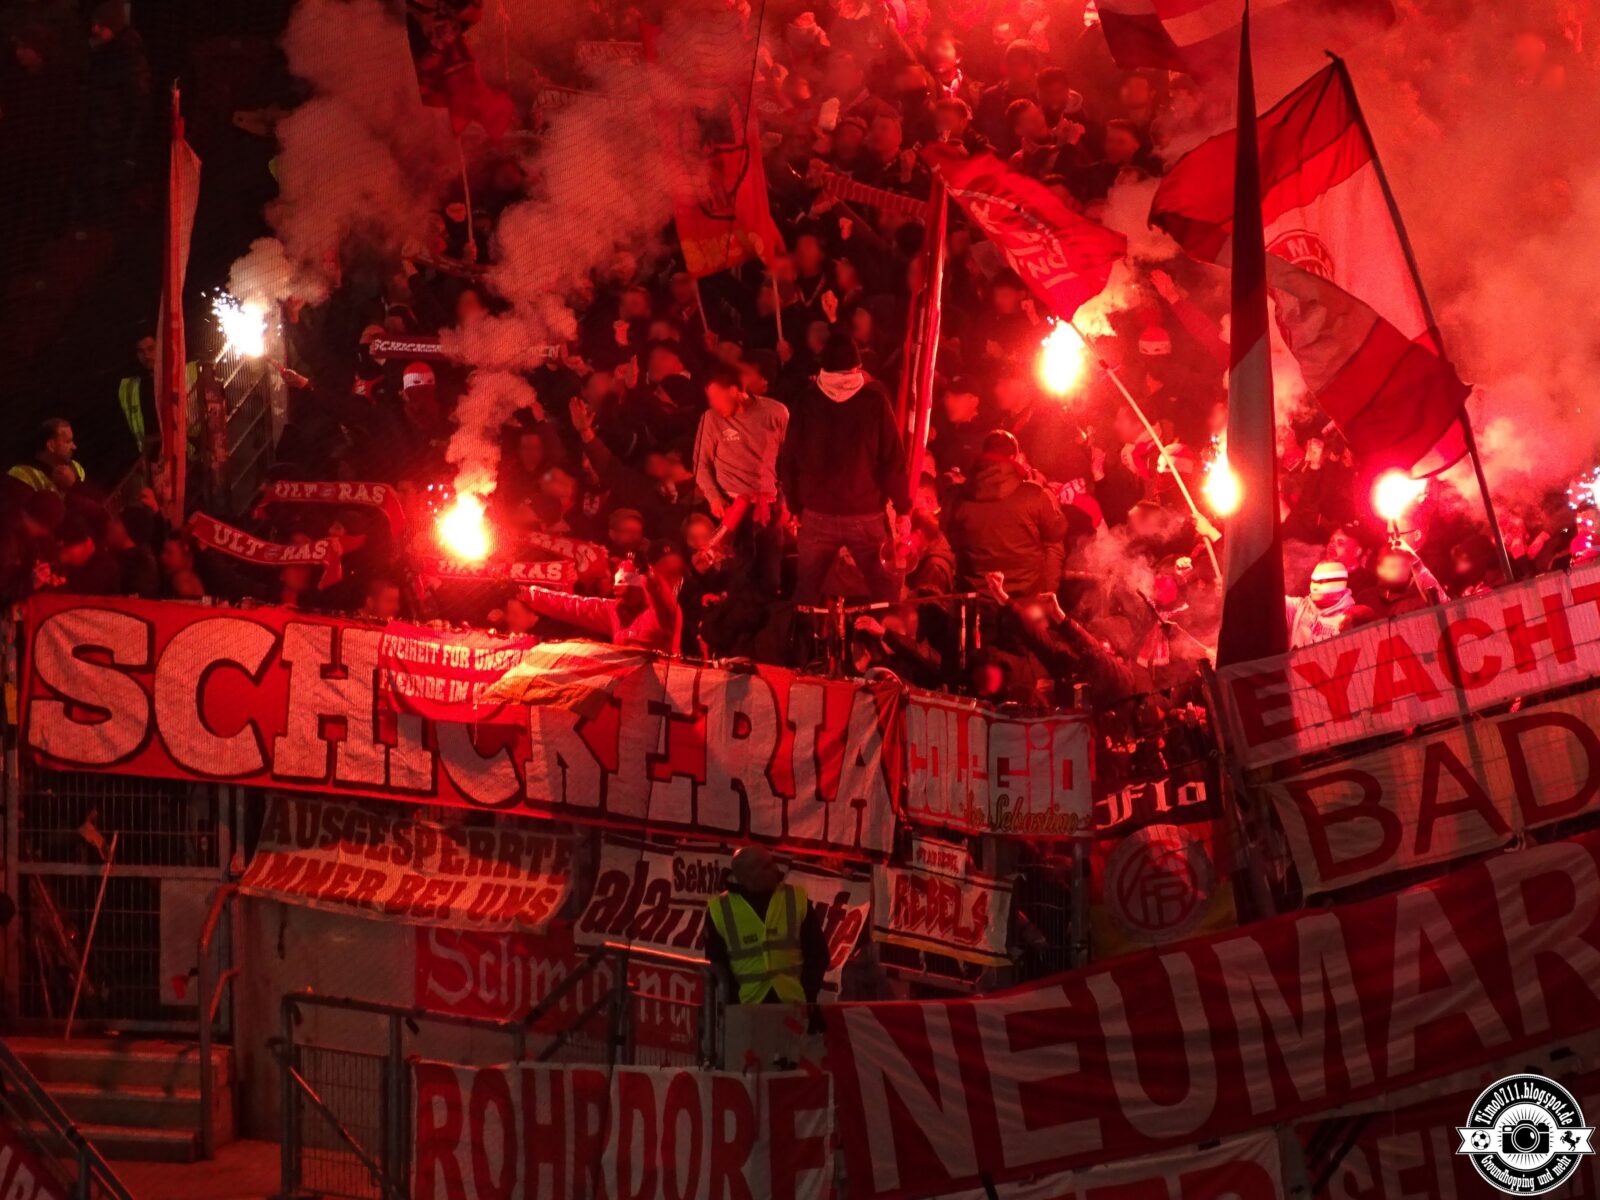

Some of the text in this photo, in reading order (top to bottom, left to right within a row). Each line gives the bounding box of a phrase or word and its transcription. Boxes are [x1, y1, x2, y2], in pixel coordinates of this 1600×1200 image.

[1288, 710, 1600, 880] BAD
[240, 850, 559, 925] IMMER BEI UNS
[673, 857, 733, 894] Sektio
